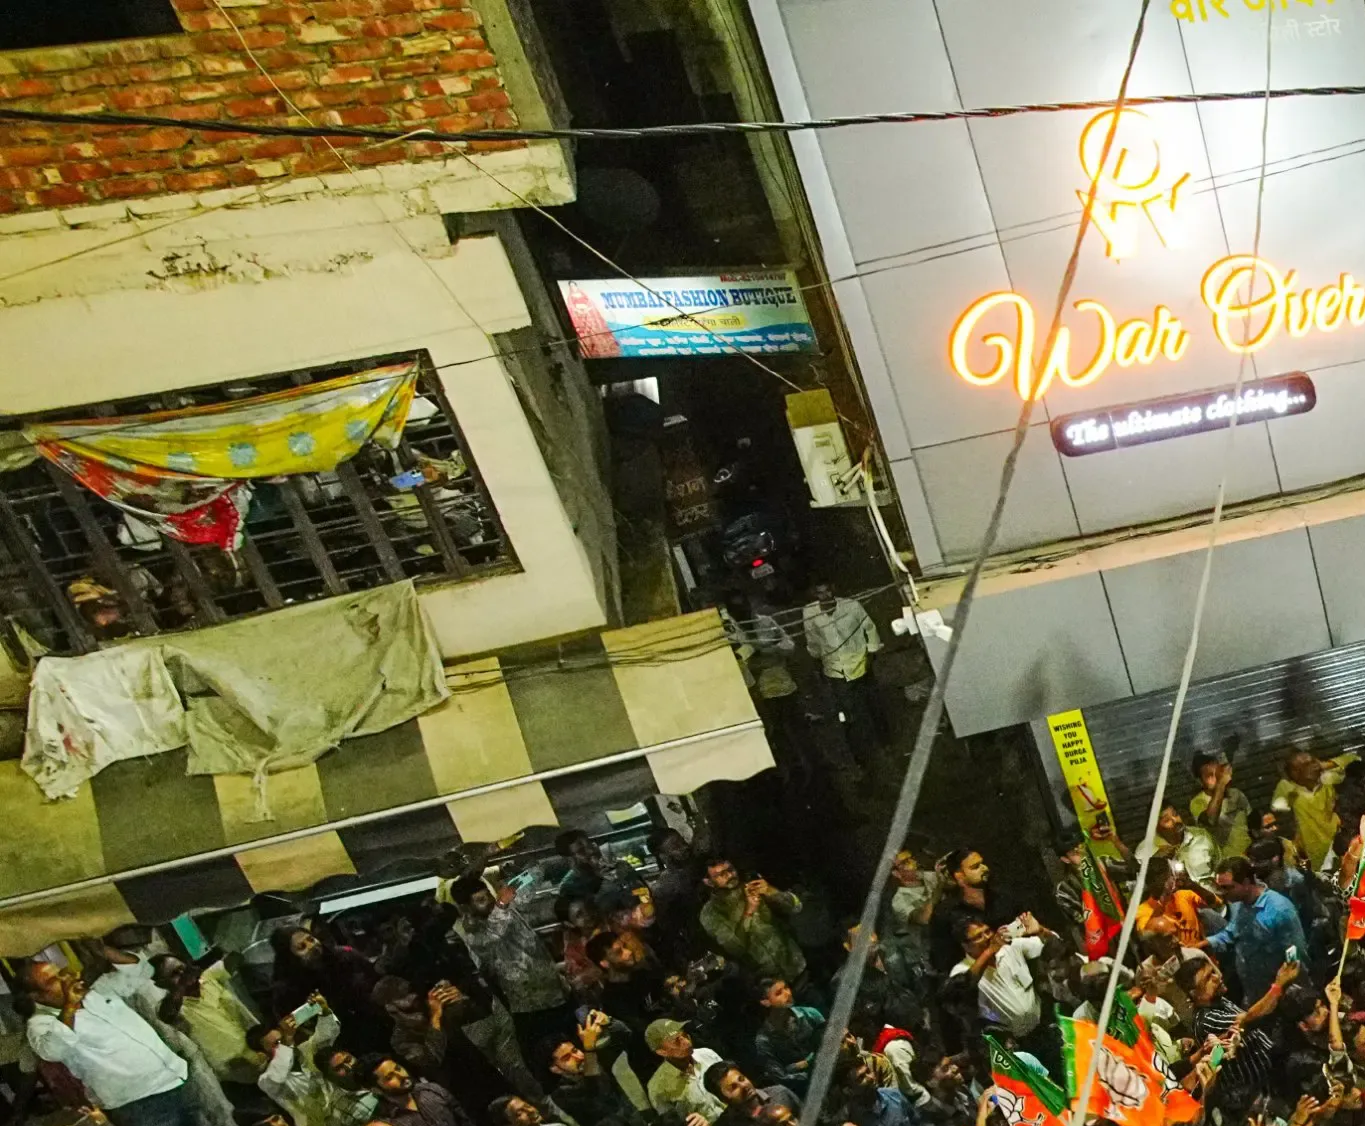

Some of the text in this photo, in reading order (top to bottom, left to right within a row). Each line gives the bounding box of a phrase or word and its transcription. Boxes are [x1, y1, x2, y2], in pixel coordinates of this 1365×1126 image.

[601, 286, 798, 310] MUMBAI FASHION BUTIQUE
[949, 291, 1190, 401] War
[1066, 414, 1109, 447] The
[1111, 402, 1202, 438] ultimate
[1053, 721, 1083, 733] WISHING
[1063, 731, 1077, 740] YOU
[1062, 739, 1084, 749] HAPPY
[1069, 758, 1088, 766] PUJA
